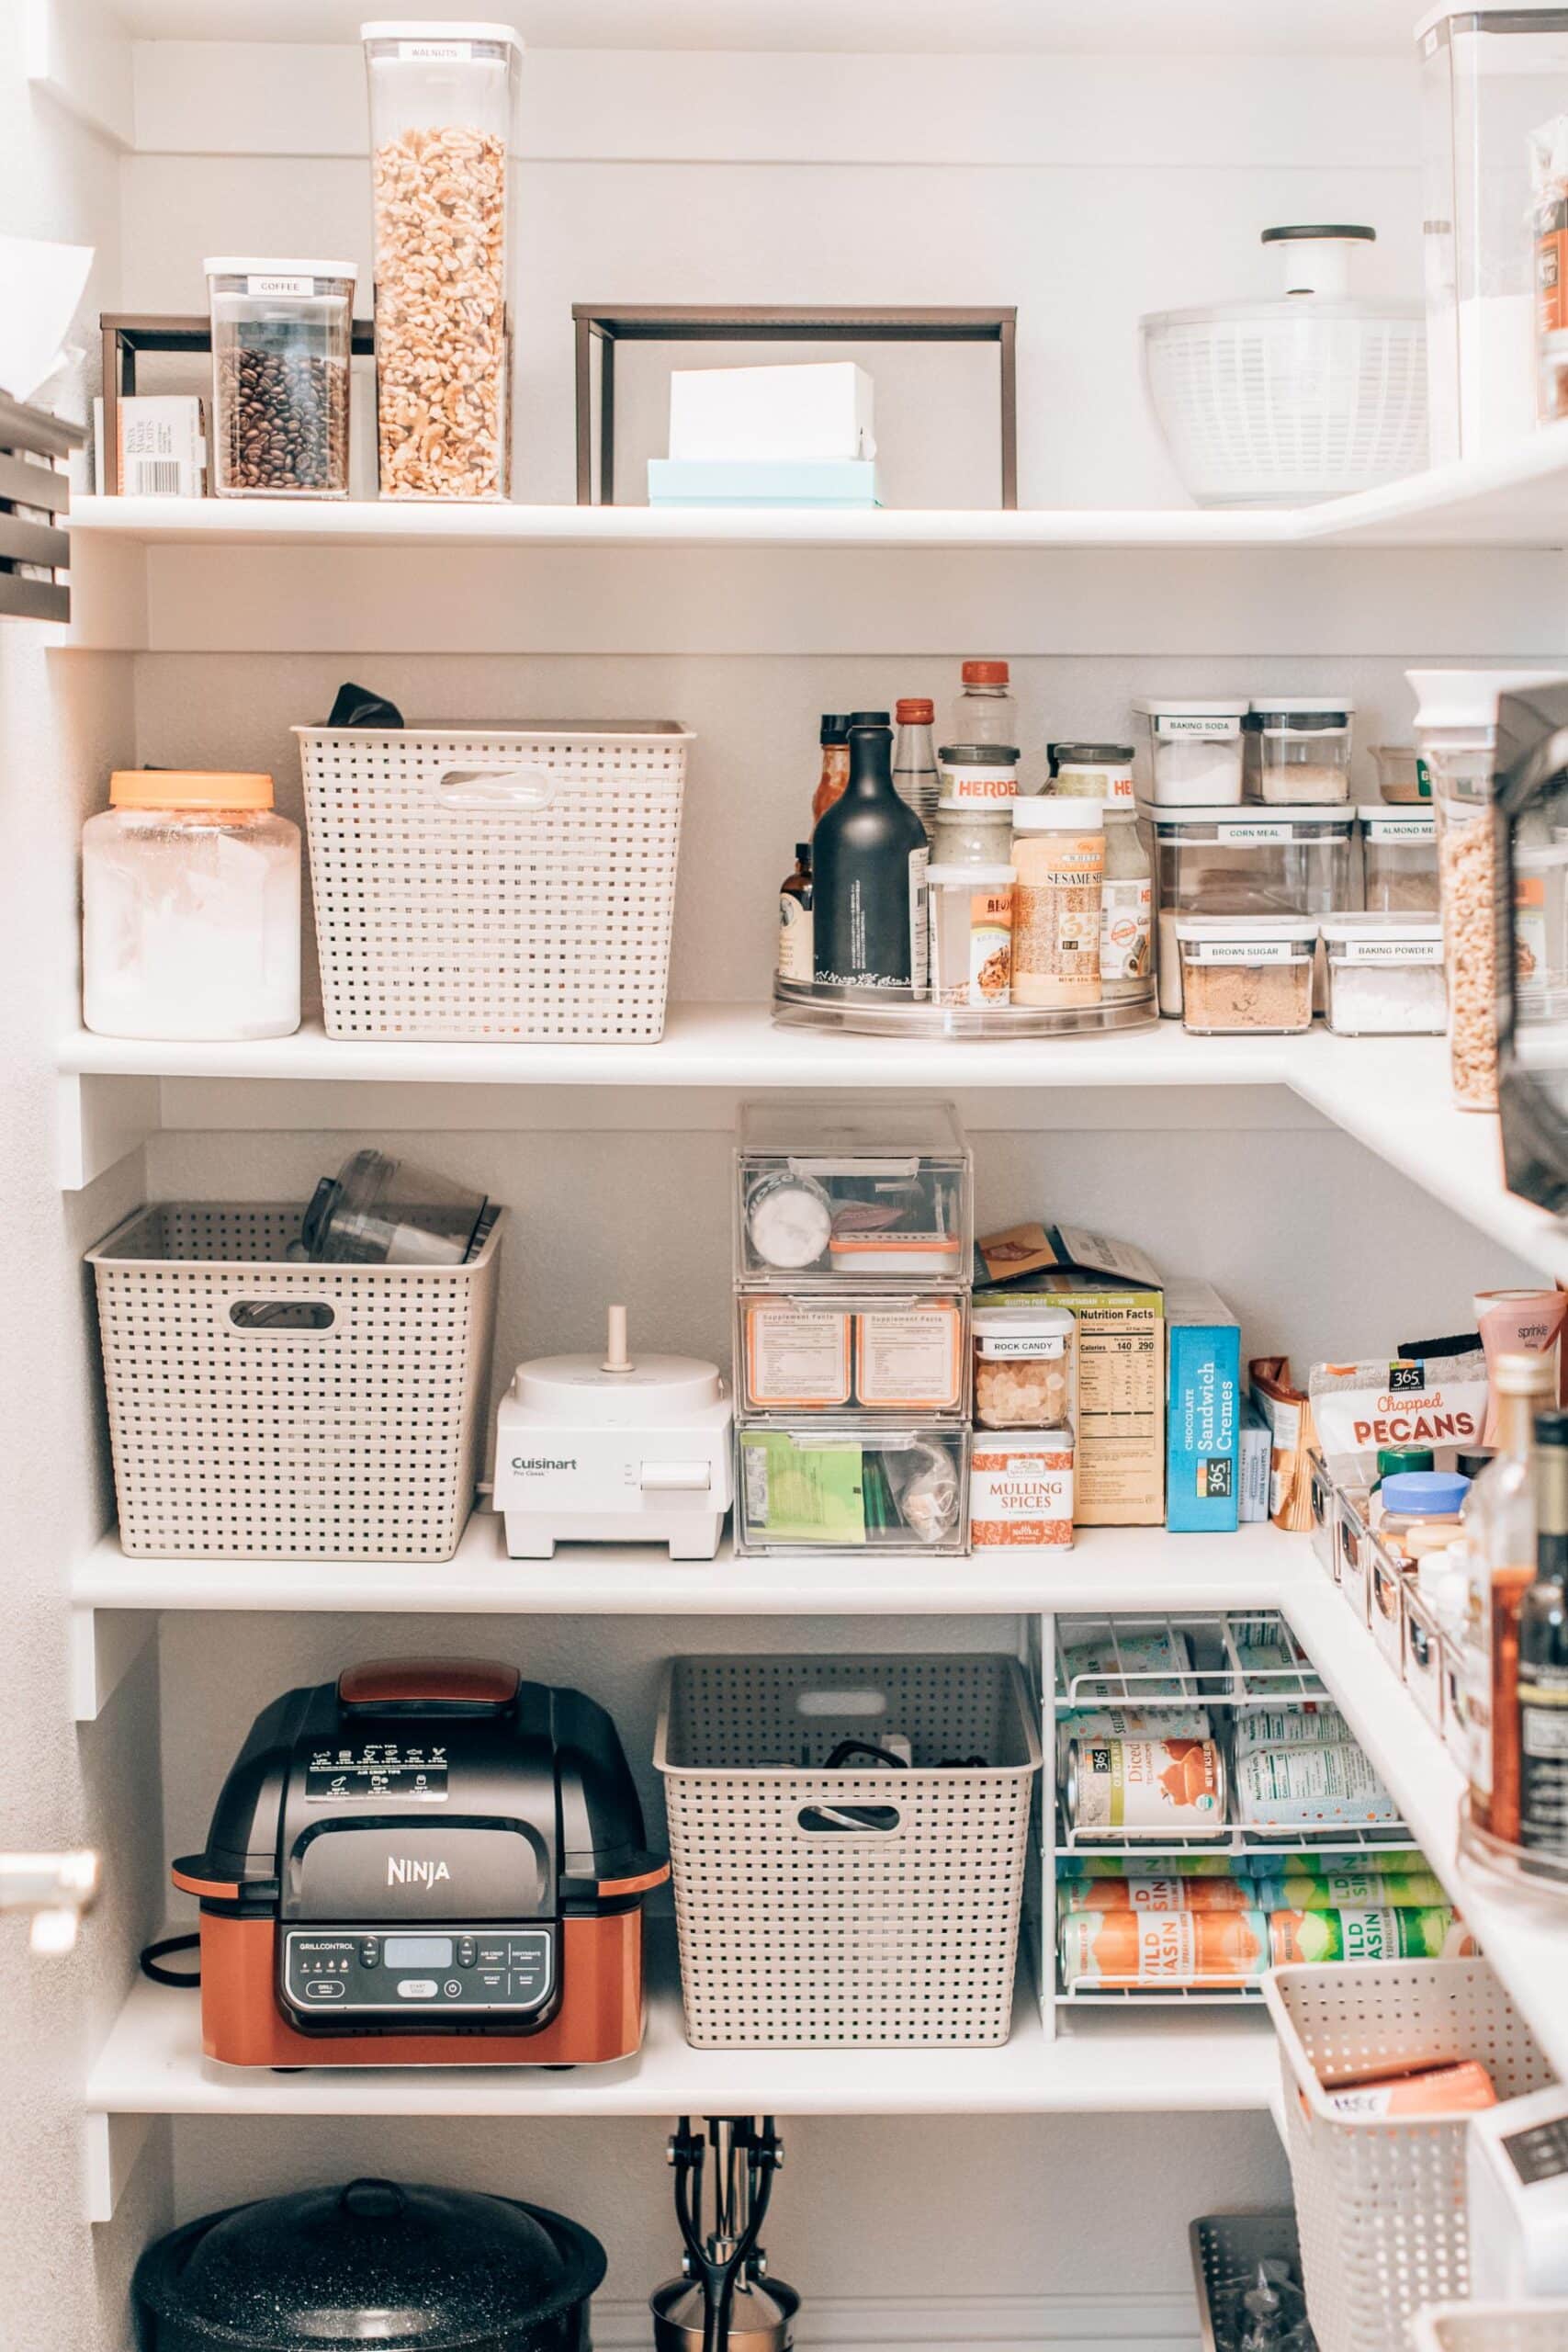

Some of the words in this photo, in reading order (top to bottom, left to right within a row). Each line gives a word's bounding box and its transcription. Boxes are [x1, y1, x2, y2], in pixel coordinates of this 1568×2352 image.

[412, 49, 457, 57] WALNUTS
[261, 282, 299, 291] COFFEE
[1047, 873, 1090, 885] SESAME
[1247, 947, 1279, 956] SUGAR
[1359, 946, 1392, 955] BAKING
[1394, 946, 1434, 955] POWDER
[1080, 1309, 1123, 1319] Nutrition
[1126, 1309, 1154, 1319] Facts
[1393, 1369, 1420, 1387] 365
[1198, 1362, 1214, 1451] Sandwich
[1377, 1392, 1444, 1414] Chopped
[1185, 1388, 1194, 1450] CHOCOLATE
[1216, 1381, 1233, 1451] Cremes
[1353, 1411, 1474, 1446] PECANS
[512, 1457, 577, 1470] Cuisinart
[1208, 1463, 1226, 1493] 365
[989, 1482, 1062, 1496] MULLING
[1001, 1496, 1052, 1509] SPICES
[1095, 1751, 1108, 1770] 365
[1126, 1743, 1143, 1782] Diced
[388, 1855, 450, 1889] NINJA
[1348, 1923, 1364, 1960] ILD
[1365, 1914, 1382, 1960] ASIN
